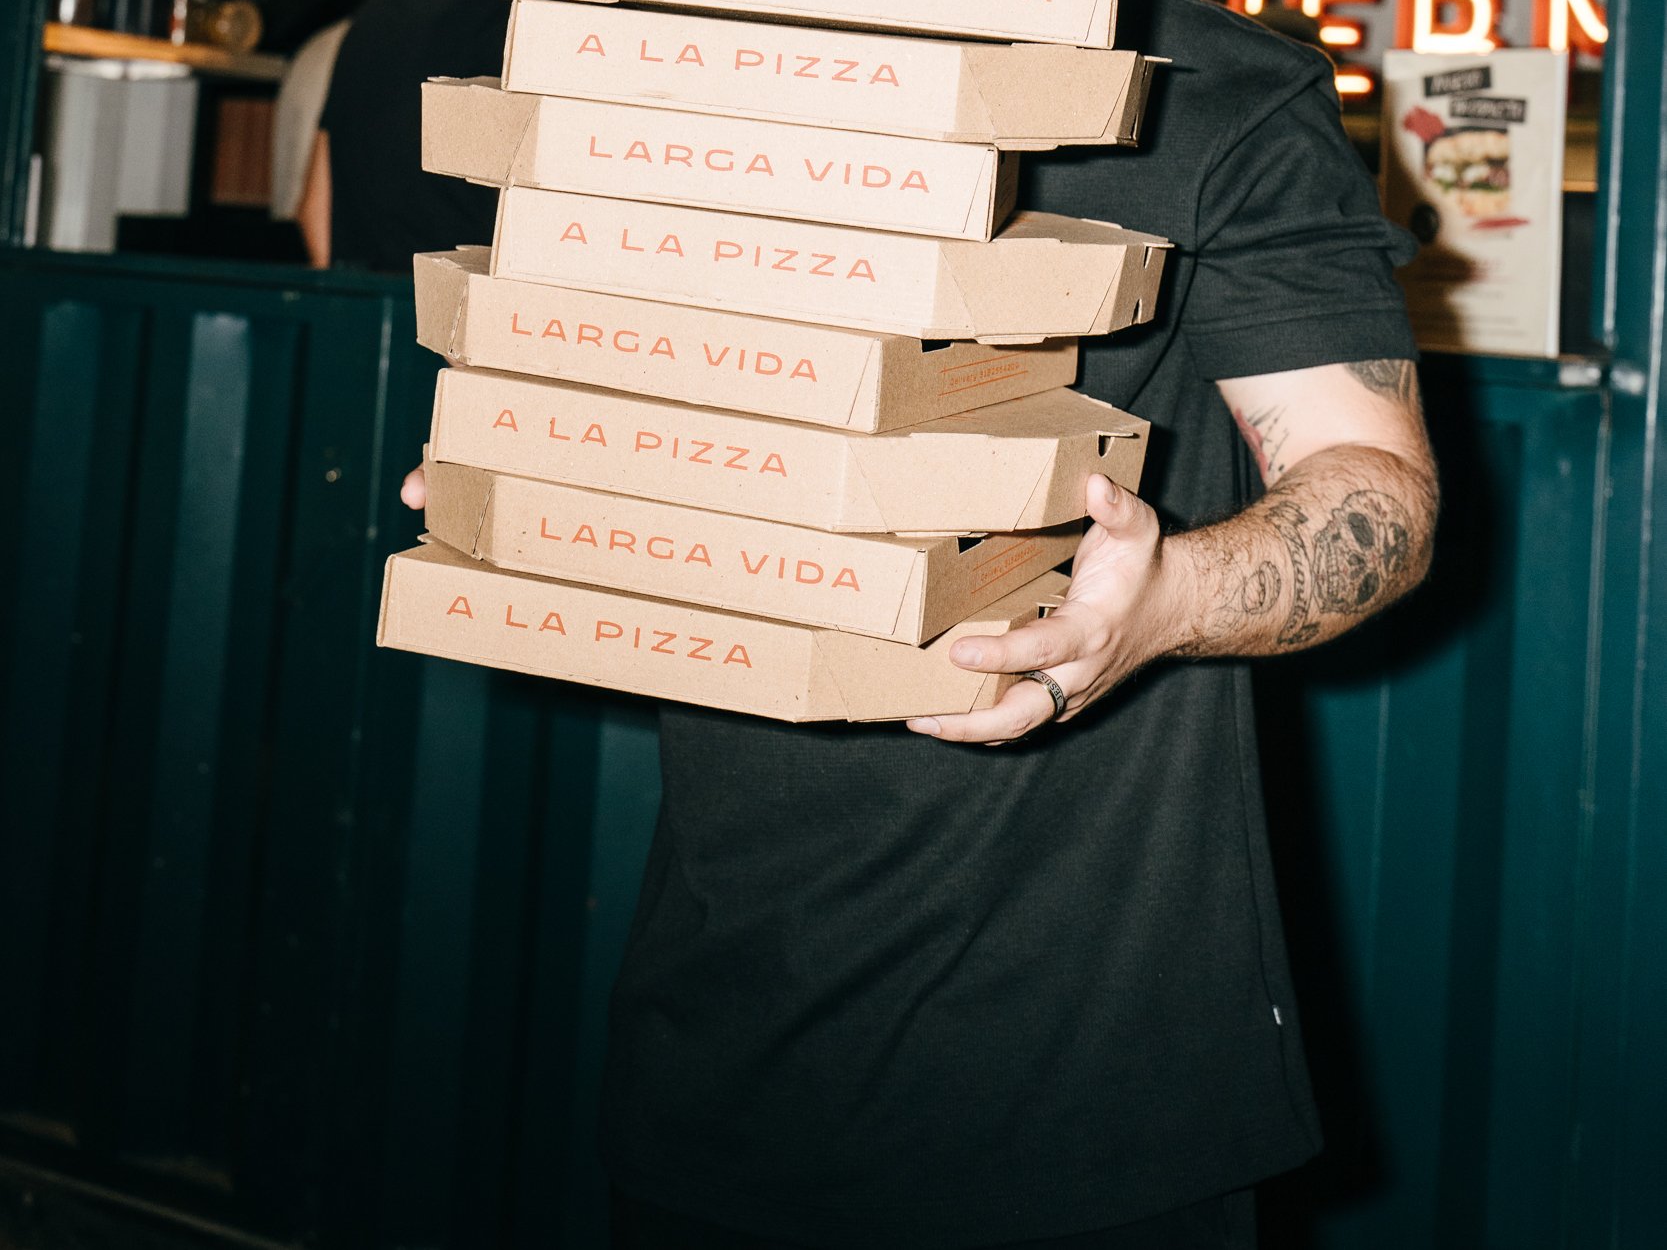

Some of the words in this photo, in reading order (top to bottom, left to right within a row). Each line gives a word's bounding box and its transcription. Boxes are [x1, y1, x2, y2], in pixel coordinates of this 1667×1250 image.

[576, 33, 606, 58] A
[640, 39, 705, 68] LA
[734, 49, 900, 88] PIZZA
[589, 134, 774, 177] LARGA
[804, 158, 930, 194] VIDA
[559, 221, 587, 245] A
[621, 229, 685, 258] LA
[713, 240, 876, 283] PIZZA
[511, 312, 676, 360] LARGA
[703, 342, 818, 384] VIDA
[492, 408, 519, 432] A
[549, 416, 607, 448] LA
[634, 430, 788, 478] PIZZA
[540, 516, 713, 569] LARGA
[741, 549, 861, 592] VIDA
[446, 594, 474, 619] A
[505, 604, 567, 637] LA
[594, 619, 753, 669] PIZZA
[1039, 675, 1063, 701] JESUS
